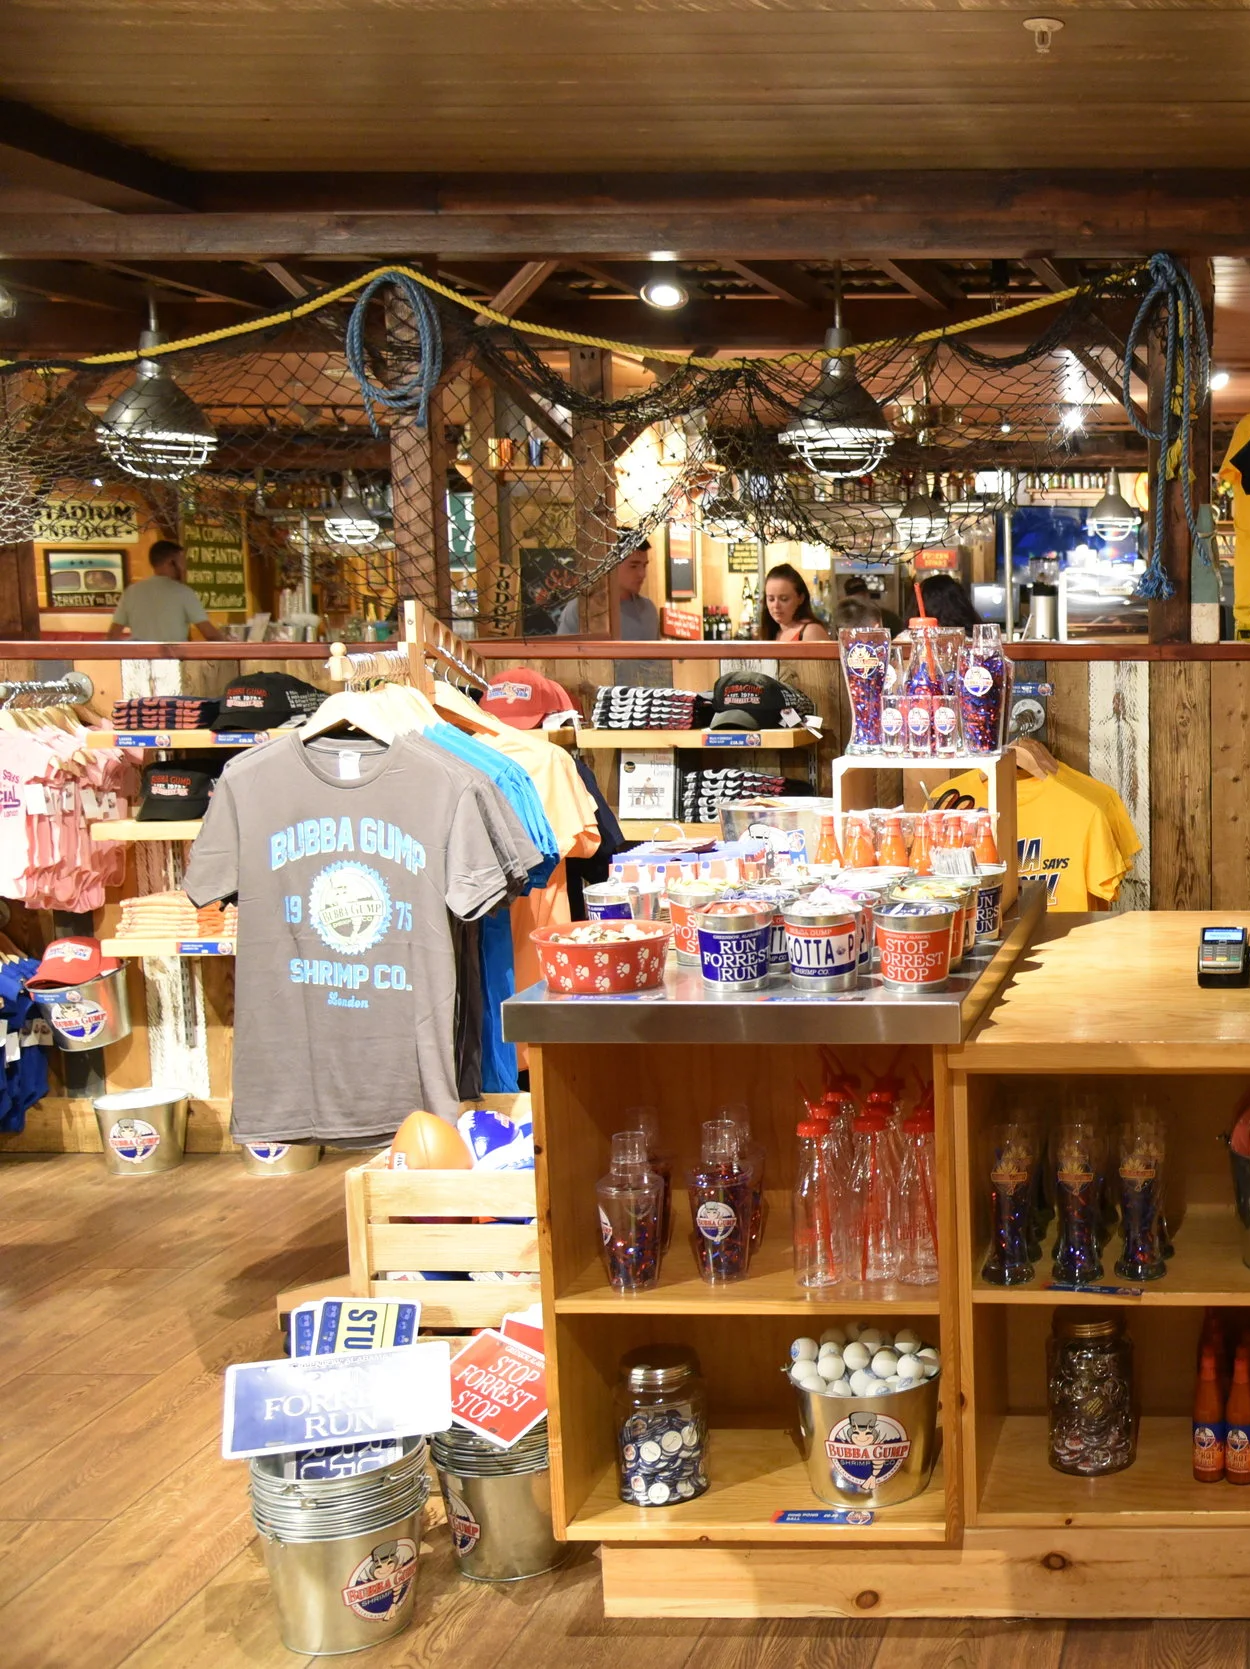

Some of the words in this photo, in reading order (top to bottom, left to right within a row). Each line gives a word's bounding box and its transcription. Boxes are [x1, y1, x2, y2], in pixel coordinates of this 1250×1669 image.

[201, 547, 242, 564] INFANTRY
[170, 776, 192, 785] GUMP
[0, 785, 20, 802] IAL
[269, 817, 354, 871] BUBBA
[360, 817, 426, 875] GUMP
[1042, 858, 1070, 870] SAYS
[977, 895, 993, 909] UN
[285, 896, 302, 924] 19
[396, 902, 412, 932] 75
[322, 906, 349, 921] BUBBA
[351, 904, 381, 915] GUMP
[976, 920, 993, 933] UN
[719, 938, 756, 954] RUN
[886, 938, 929, 954] STOP
[289, 958, 369, 989] SHRIMP
[374, 964, 412, 991] CO.
[720, 965, 757, 982] RUN
[795, 967, 816, 975] SHRIMP
[887, 966, 928, 982] STOP
[81, 1013, 106, 1024] GUMP
[718, 1219, 737, 1227] GUMP
[344, 1309, 378, 1350] STU
[488, 1356, 541, 1386] STOP
[454, 1364, 538, 1412] FORREST
[452, 1390, 501, 1422] STOP
[304, 1409, 377, 1439] RUN
[828, 1443, 870, 1458] BUBBA
[872, 1444, 908, 1458] GUMP
[453, 1521, 479, 1537] GUMP
[347, 1579, 391, 1601] BUBBA
[361, 1591, 392, 1607] SHRIMP
